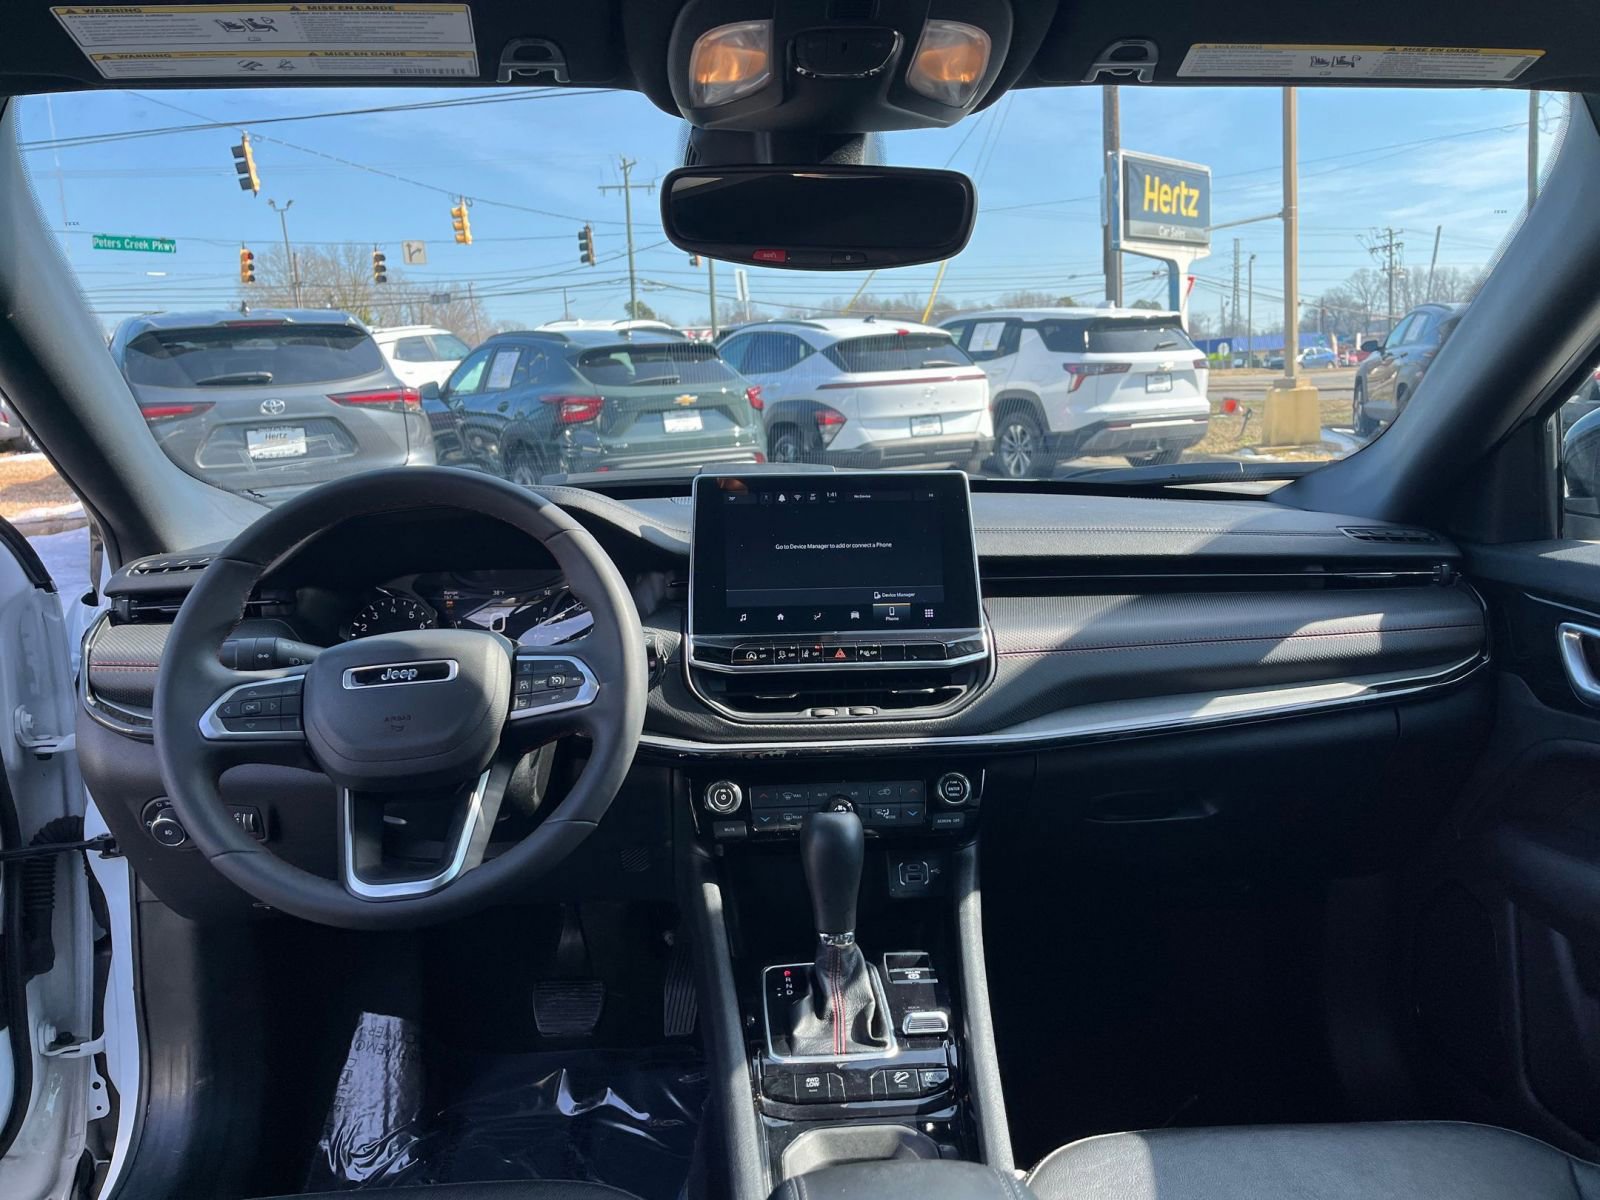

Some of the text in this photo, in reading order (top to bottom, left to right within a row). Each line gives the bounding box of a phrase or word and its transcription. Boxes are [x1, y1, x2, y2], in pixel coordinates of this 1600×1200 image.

[1143, 174, 1200, 218] Hertz
[93, 237, 176, 253] Peters Creek Pkwy
[265, 432, 287, 440] Hertz
[389, 605, 397, 614] 4
[372, 611, 379, 620] 3
[408, 610, 415, 619] 5
[360, 623, 367, 632] 2
[419, 622, 426, 630] 6
[381, 668, 418, 681] Jeep
[783, 968, 792, 977] P
